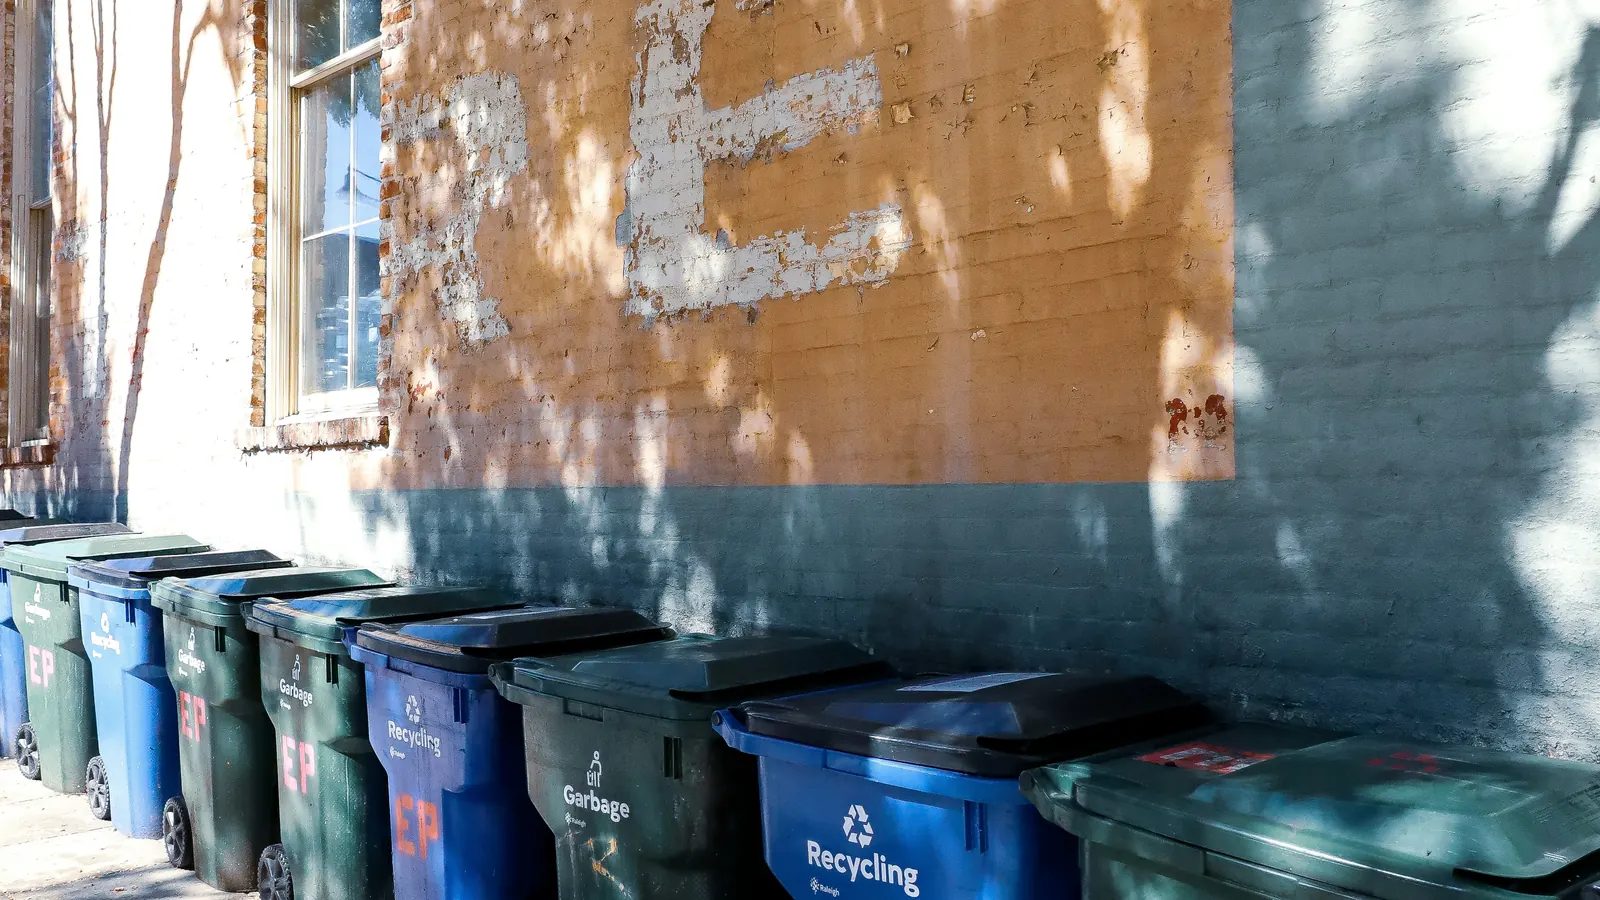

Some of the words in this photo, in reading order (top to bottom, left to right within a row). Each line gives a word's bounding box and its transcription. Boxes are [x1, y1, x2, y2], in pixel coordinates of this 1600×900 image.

[28, 645, 55, 688] EP
[178, 649, 205, 674] Garbage
[280, 678, 313, 707] Garbage
[180, 690, 206, 742] EP
[388, 720, 440, 758] Recycling
[282, 735, 315, 794] EP
[563, 784, 630, 823] Garbage
[396, 793, 439, 860] EP
[807, 839, 920, 898] Recycling
[819, 884, 840, 898] Raleigh
